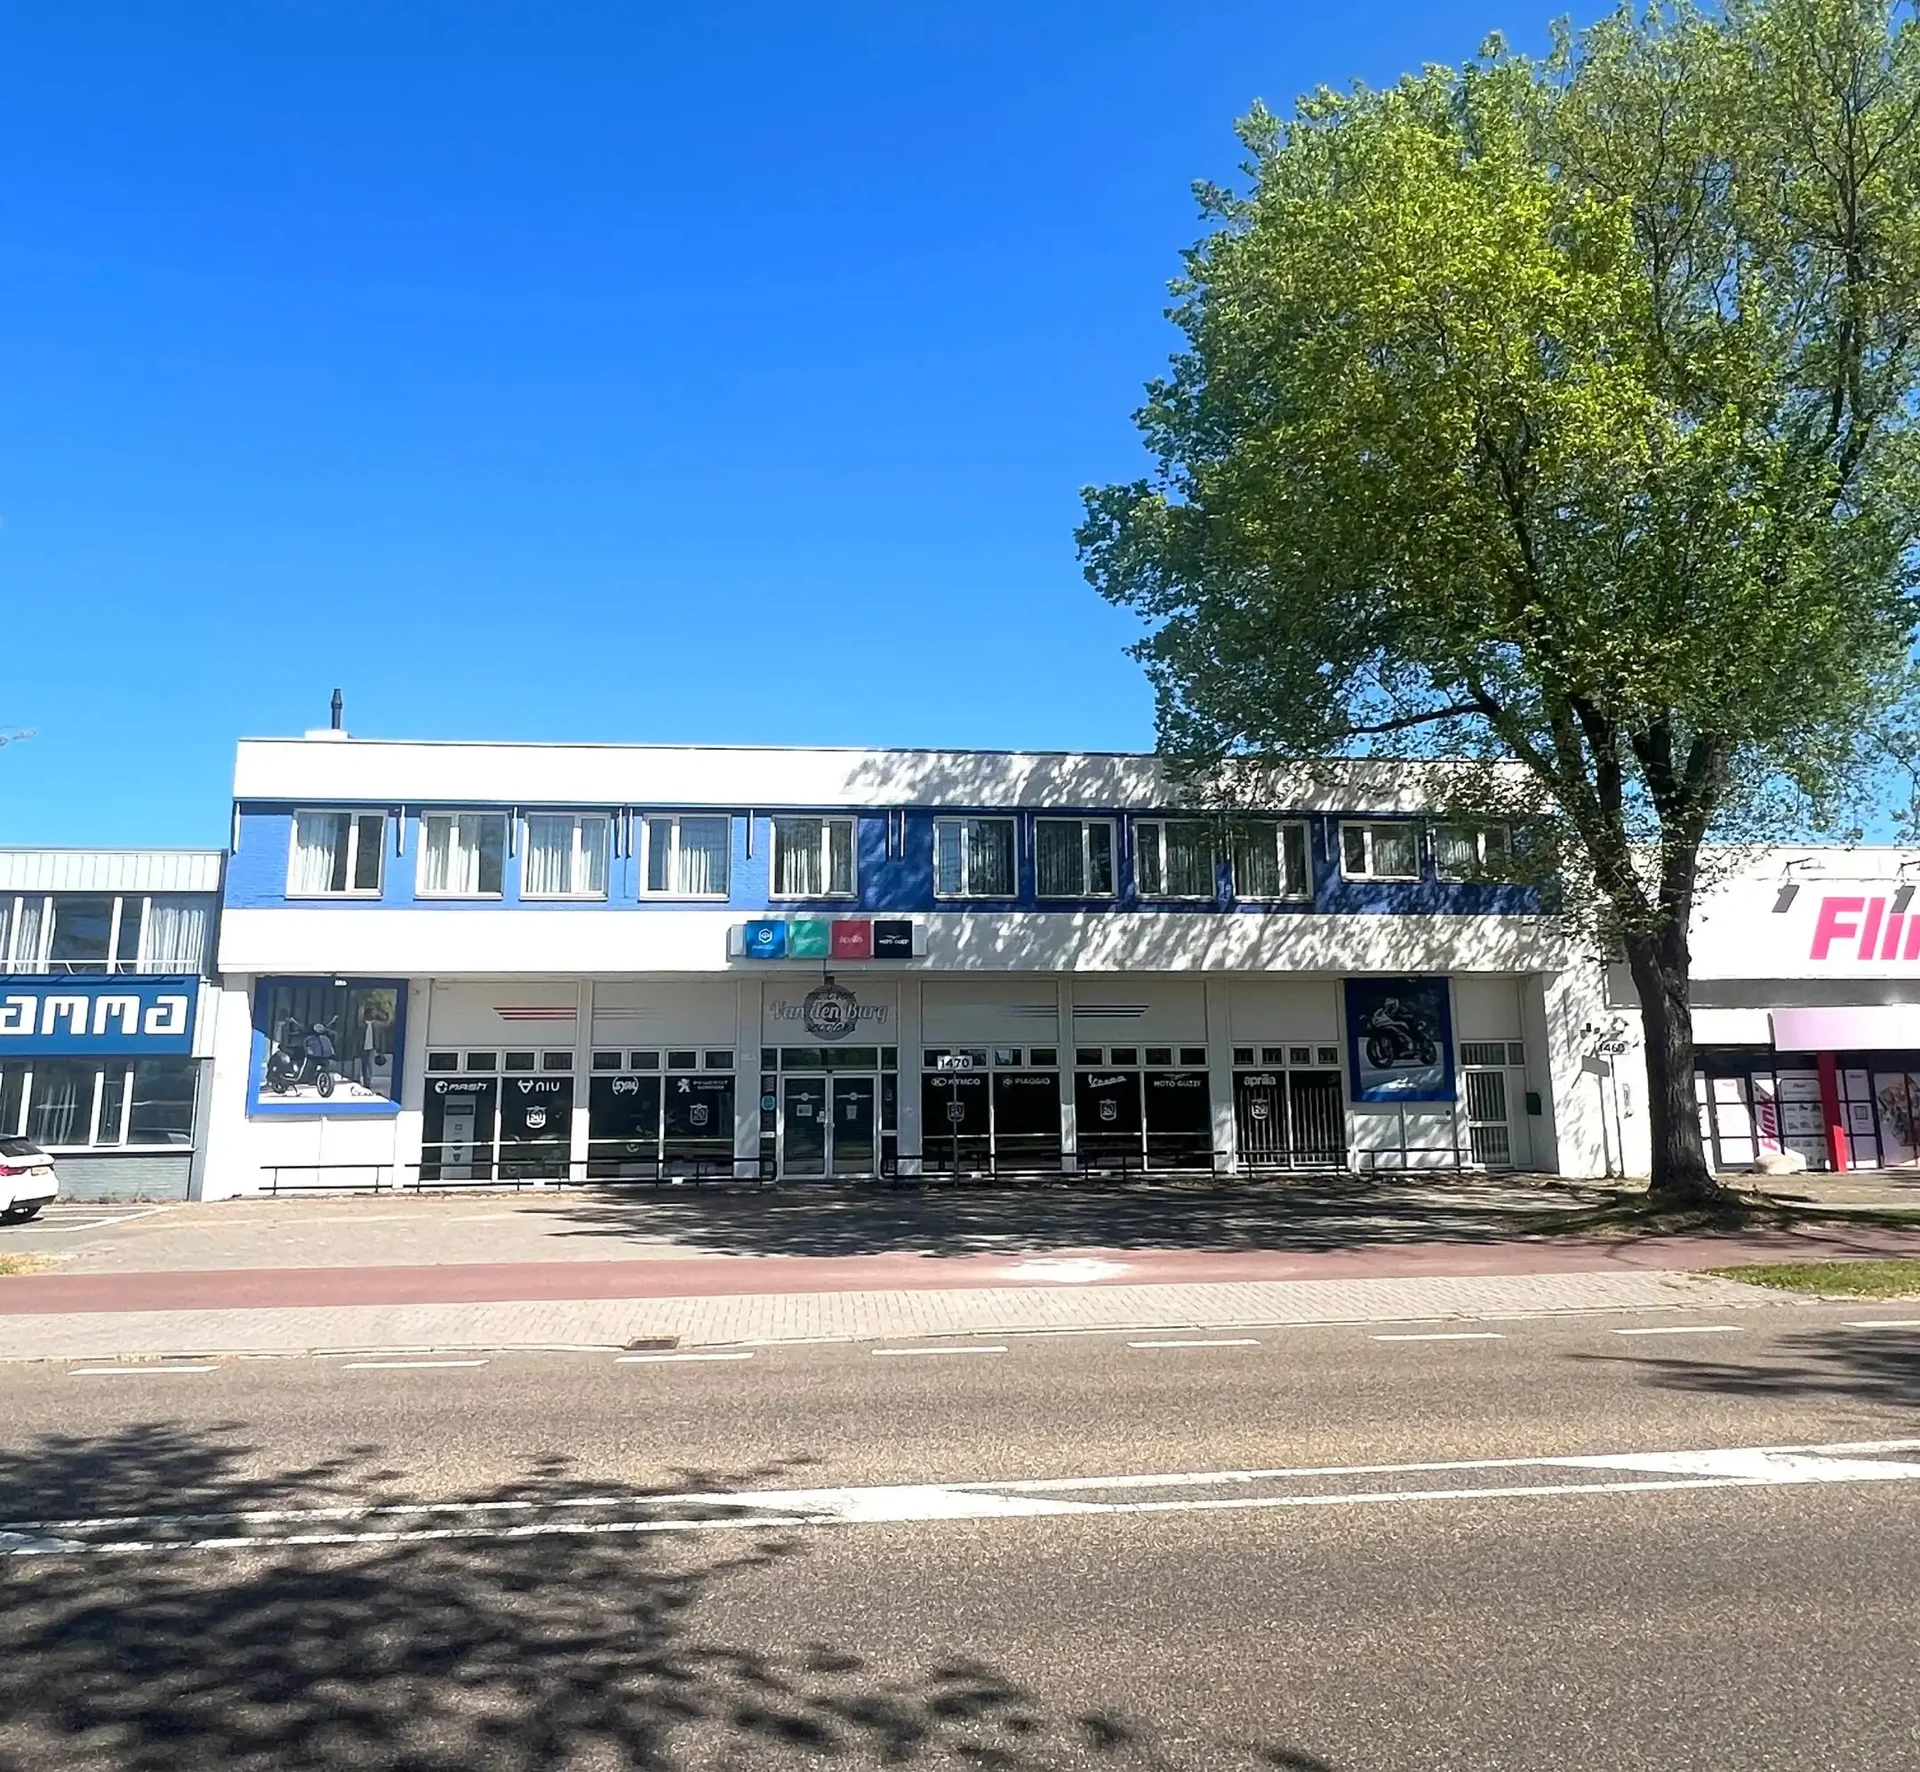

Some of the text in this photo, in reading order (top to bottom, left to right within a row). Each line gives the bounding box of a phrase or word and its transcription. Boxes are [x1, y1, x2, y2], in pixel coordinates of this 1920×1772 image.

[845, 1001, 889, 1025] Burg
[941, 1057, 970, 1069] 1470
[1153, 1080, 1176, 1088] MOTO
[1244, 1074, 1277, 1087] aprilia
